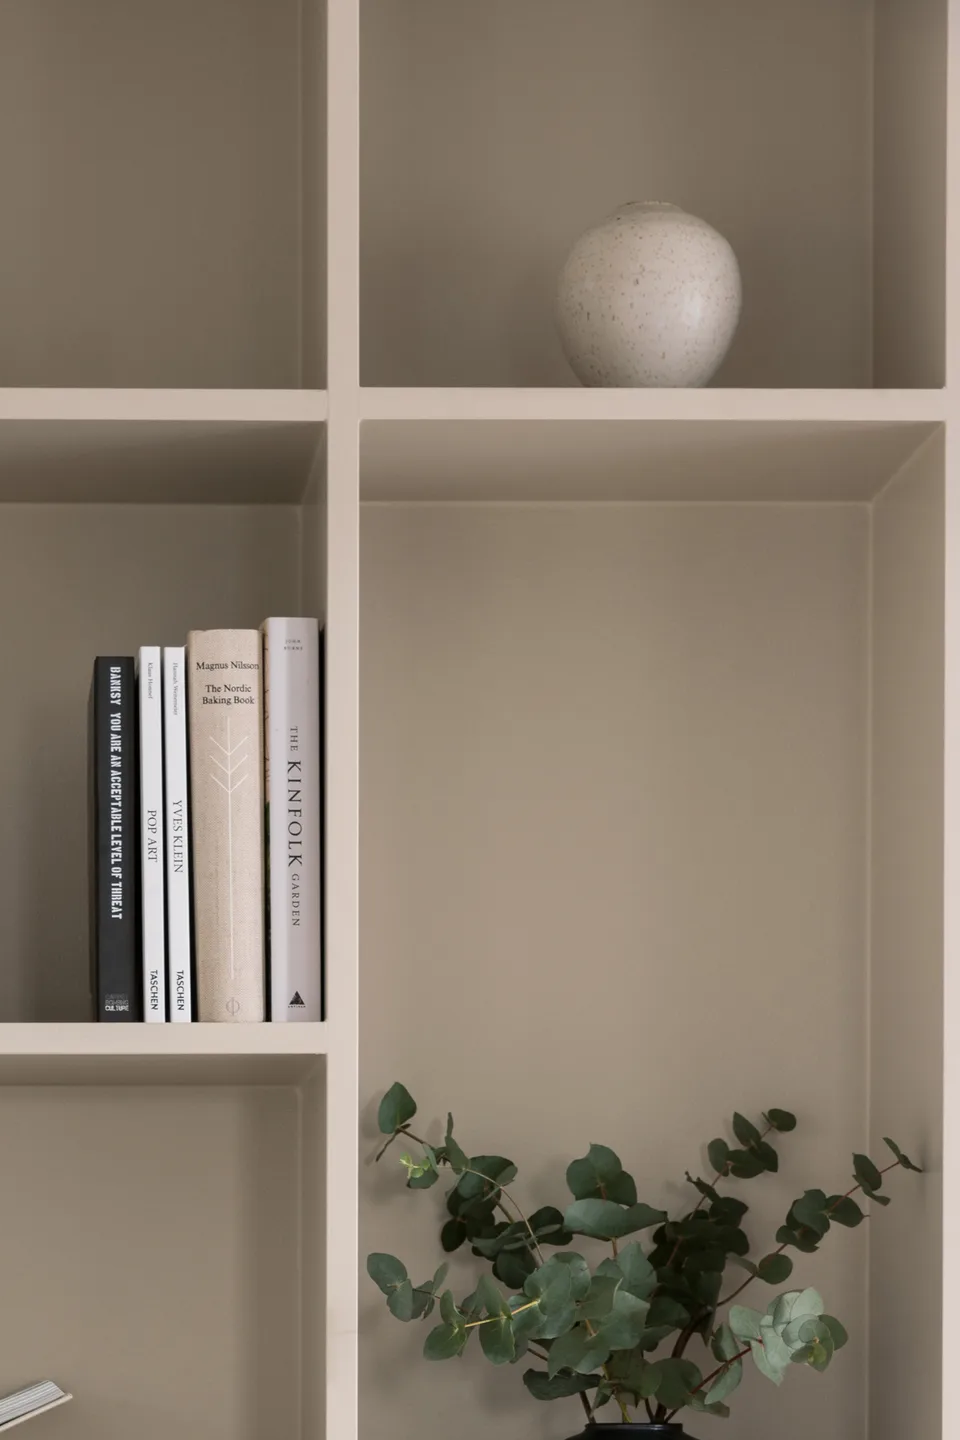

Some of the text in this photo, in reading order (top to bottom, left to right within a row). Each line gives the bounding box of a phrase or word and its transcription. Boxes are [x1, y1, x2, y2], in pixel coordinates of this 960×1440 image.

[196, 661, 260, 672] Magnus Nilsson
[202, 696, 255, 706] Baking Book
[205, 684, 252, 693] The Nordic
[110, 666, 123, 920] BANKSY YOU ARE AN ACCEPTABLE LEVEL OF THREAT
[148, 810, 158, 863] POP ART
[172, 800, 184, 874] YVES KLEIN
[287, 726, 303, 927] THE KINFOLK GARDEN
[150, 970, 159, 1010] TASCHEN
[176, 970, 185, 1011] TASCHEN
